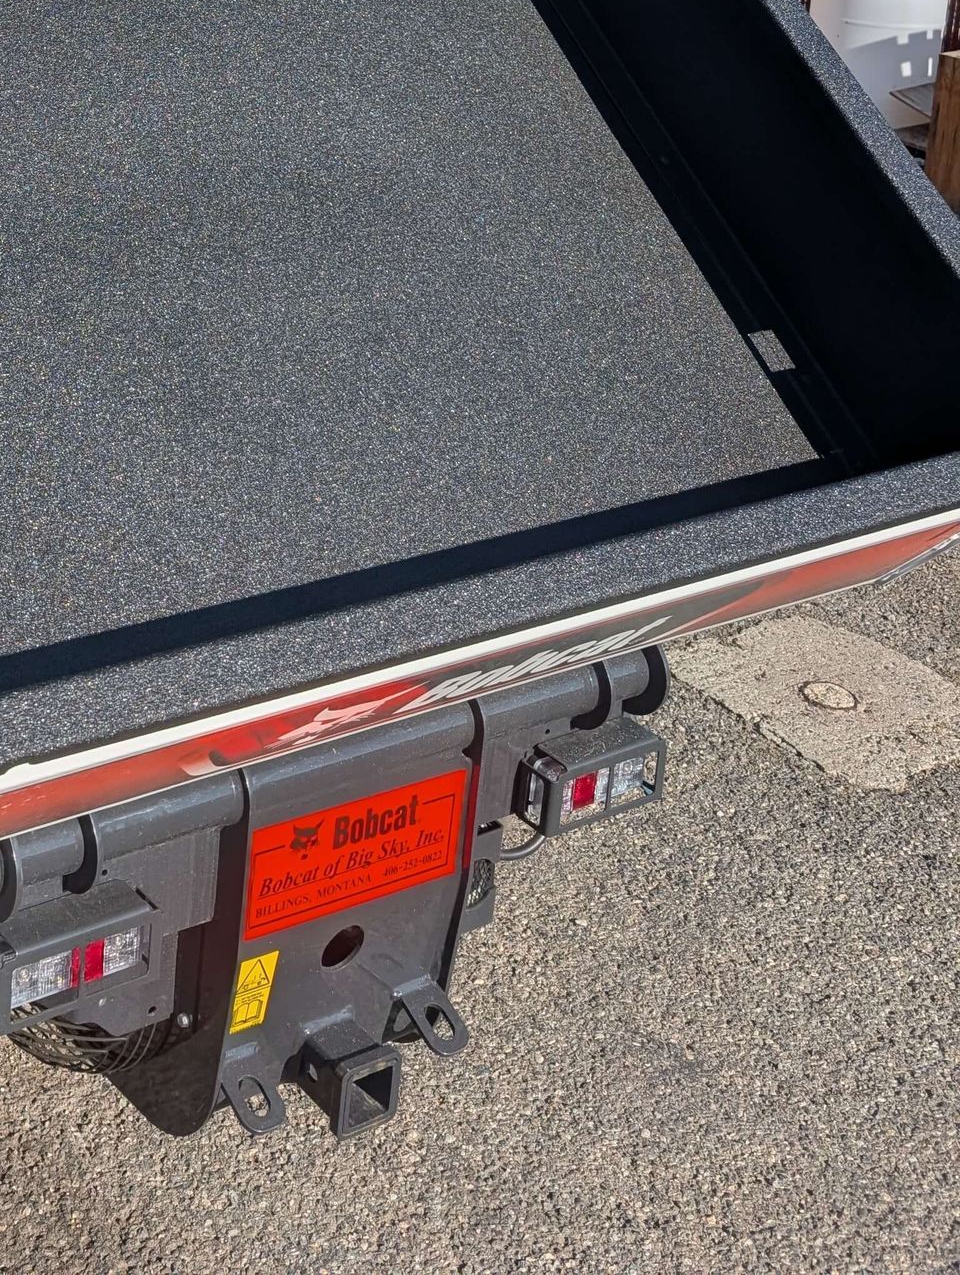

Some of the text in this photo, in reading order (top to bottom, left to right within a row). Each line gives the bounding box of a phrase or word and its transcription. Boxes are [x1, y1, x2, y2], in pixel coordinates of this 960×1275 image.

[392, 615, 674, 714] Bobcat
[331, 794, 420, 850] Bobcat
[259, 864, 321, 897] Bobcat
[323, 854, 346, 880] of
[345, 848, 374, 870] Big
[415, 829, 445, 848] Inc.
[316, 873, 373, 898] MONTANA
